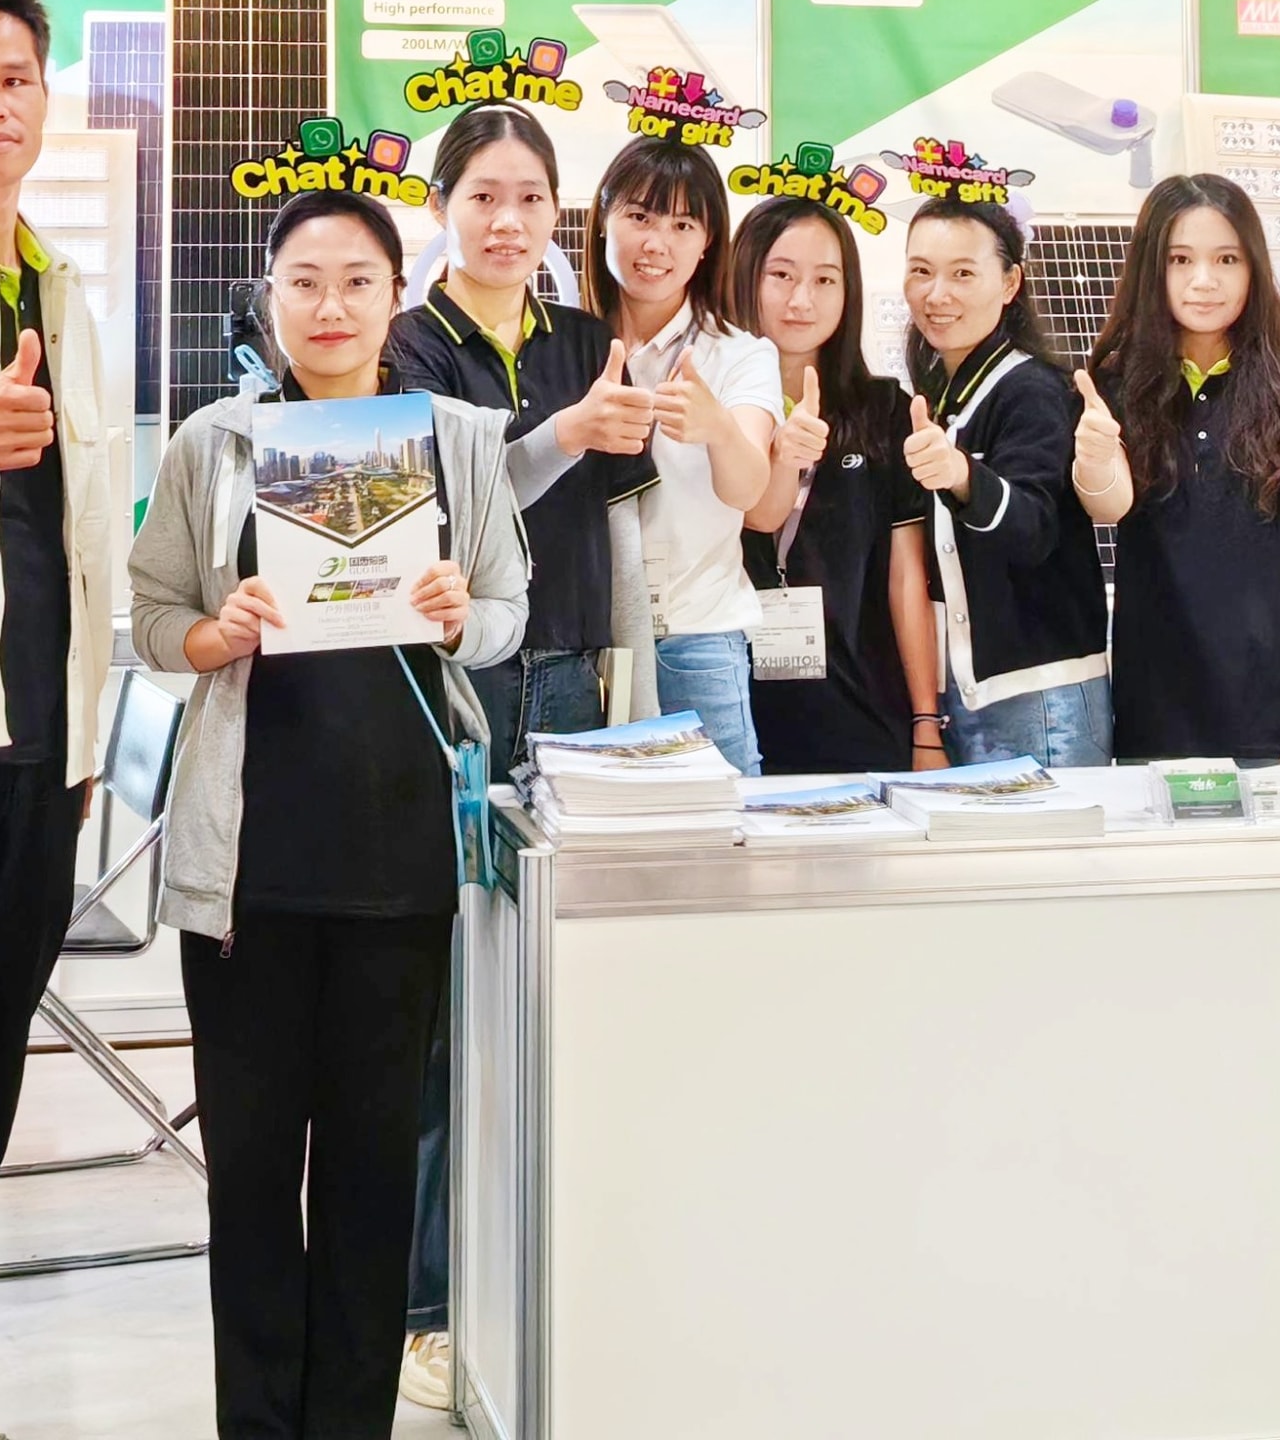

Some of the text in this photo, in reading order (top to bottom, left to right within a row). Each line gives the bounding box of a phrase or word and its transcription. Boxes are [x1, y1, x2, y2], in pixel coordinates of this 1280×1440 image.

[373, 0, 495, 19] High performance
[404, 64, 583, 112] Chat me
[627, 86, 740, 126] Namecard
[627, 106, 733, 147] for gift
[231, 154, 430, 207] Chat me
[903, 155, 1007, 185] Namecard
[909, 172, 1010, 204] for gift
[728, 162, 888, 236] Chat me
